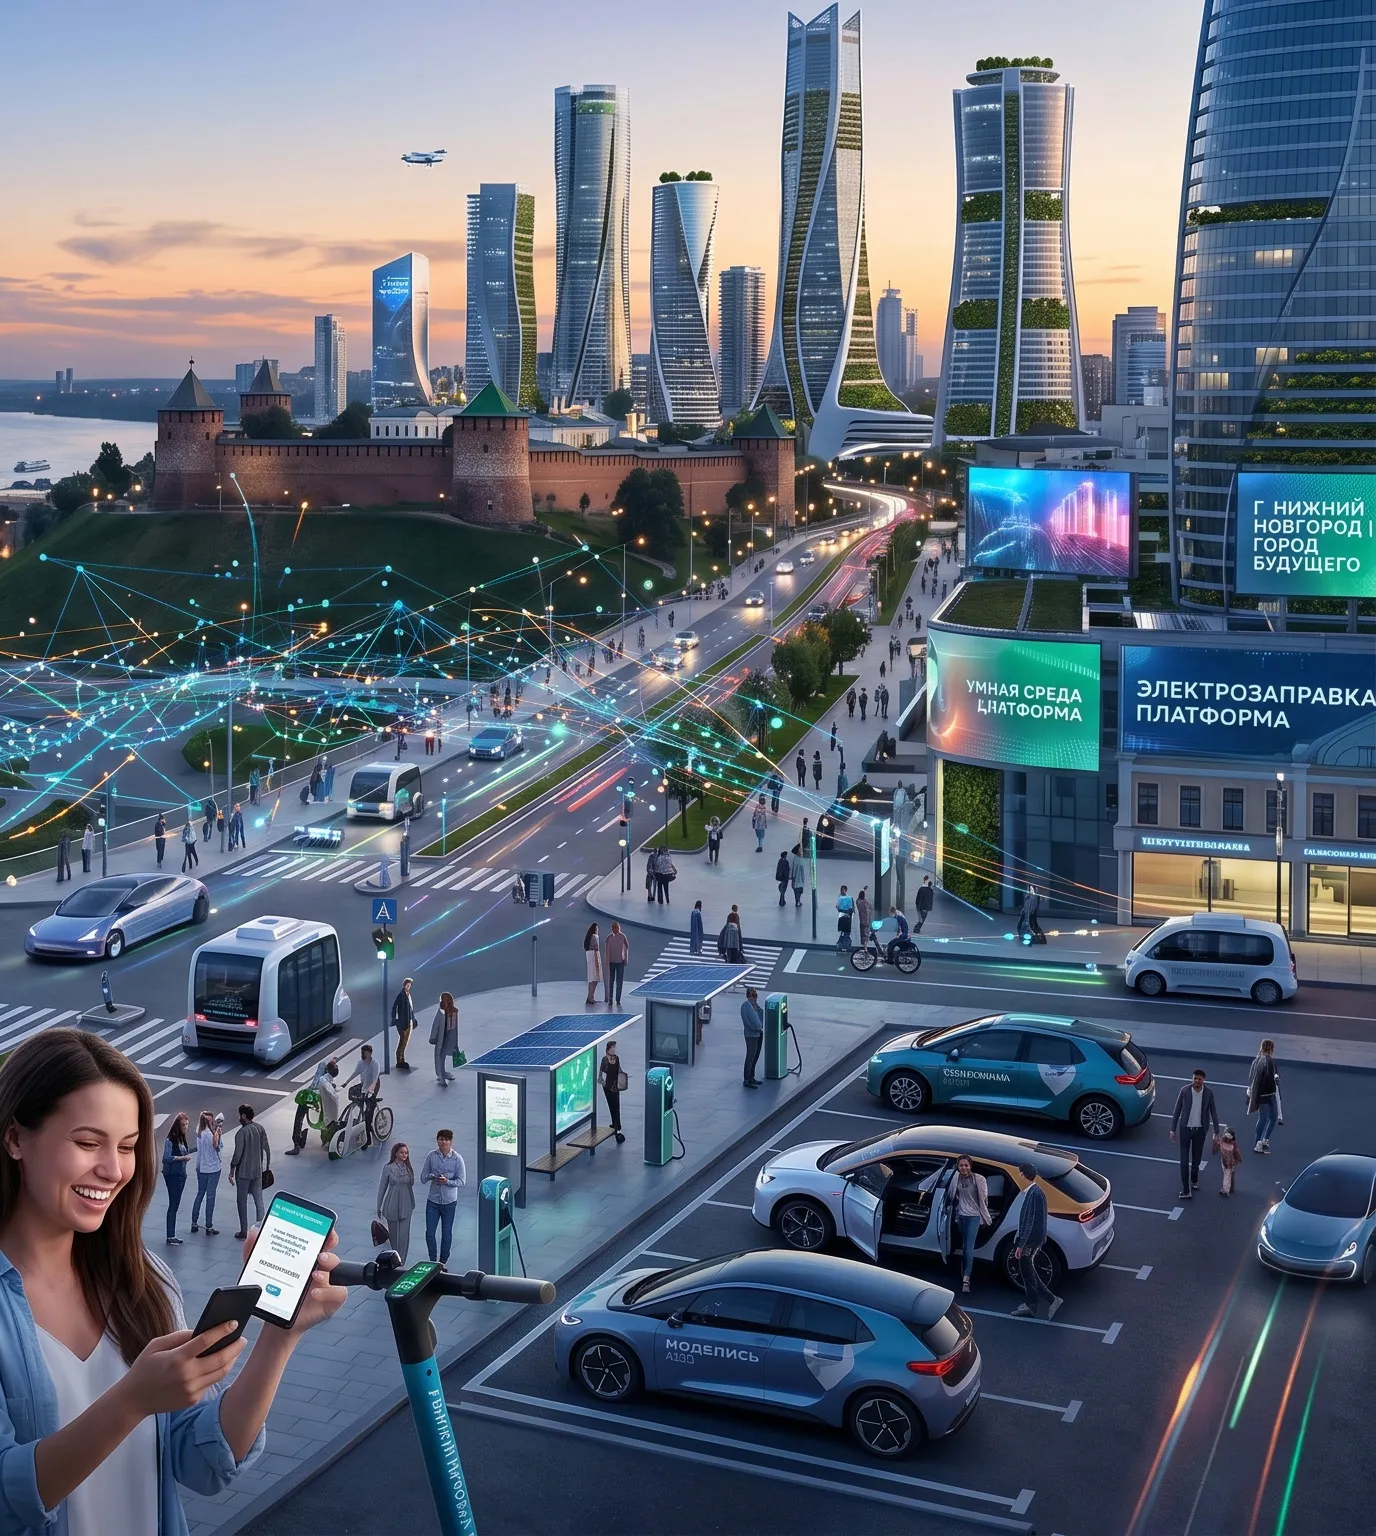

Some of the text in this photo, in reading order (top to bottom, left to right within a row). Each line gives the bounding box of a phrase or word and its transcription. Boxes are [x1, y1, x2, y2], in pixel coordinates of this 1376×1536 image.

[1253, 497, 1364, 516] Г НИЖНИЙ
[1254, 519, 1363, 538] НОВГОРОД
[1253, 537, 1319, 555] ГОРОД
[1253, 555, 1361, 574] БУДУЩЕГО
[966, 679, 1083, 704] УМНАЯ СРЕДА
[1136, 679, 1376, 707] ЭЛЕКТРОЗАПРАВКА
[1136, 704, 1291, 729] ПЛАТФОРМА
